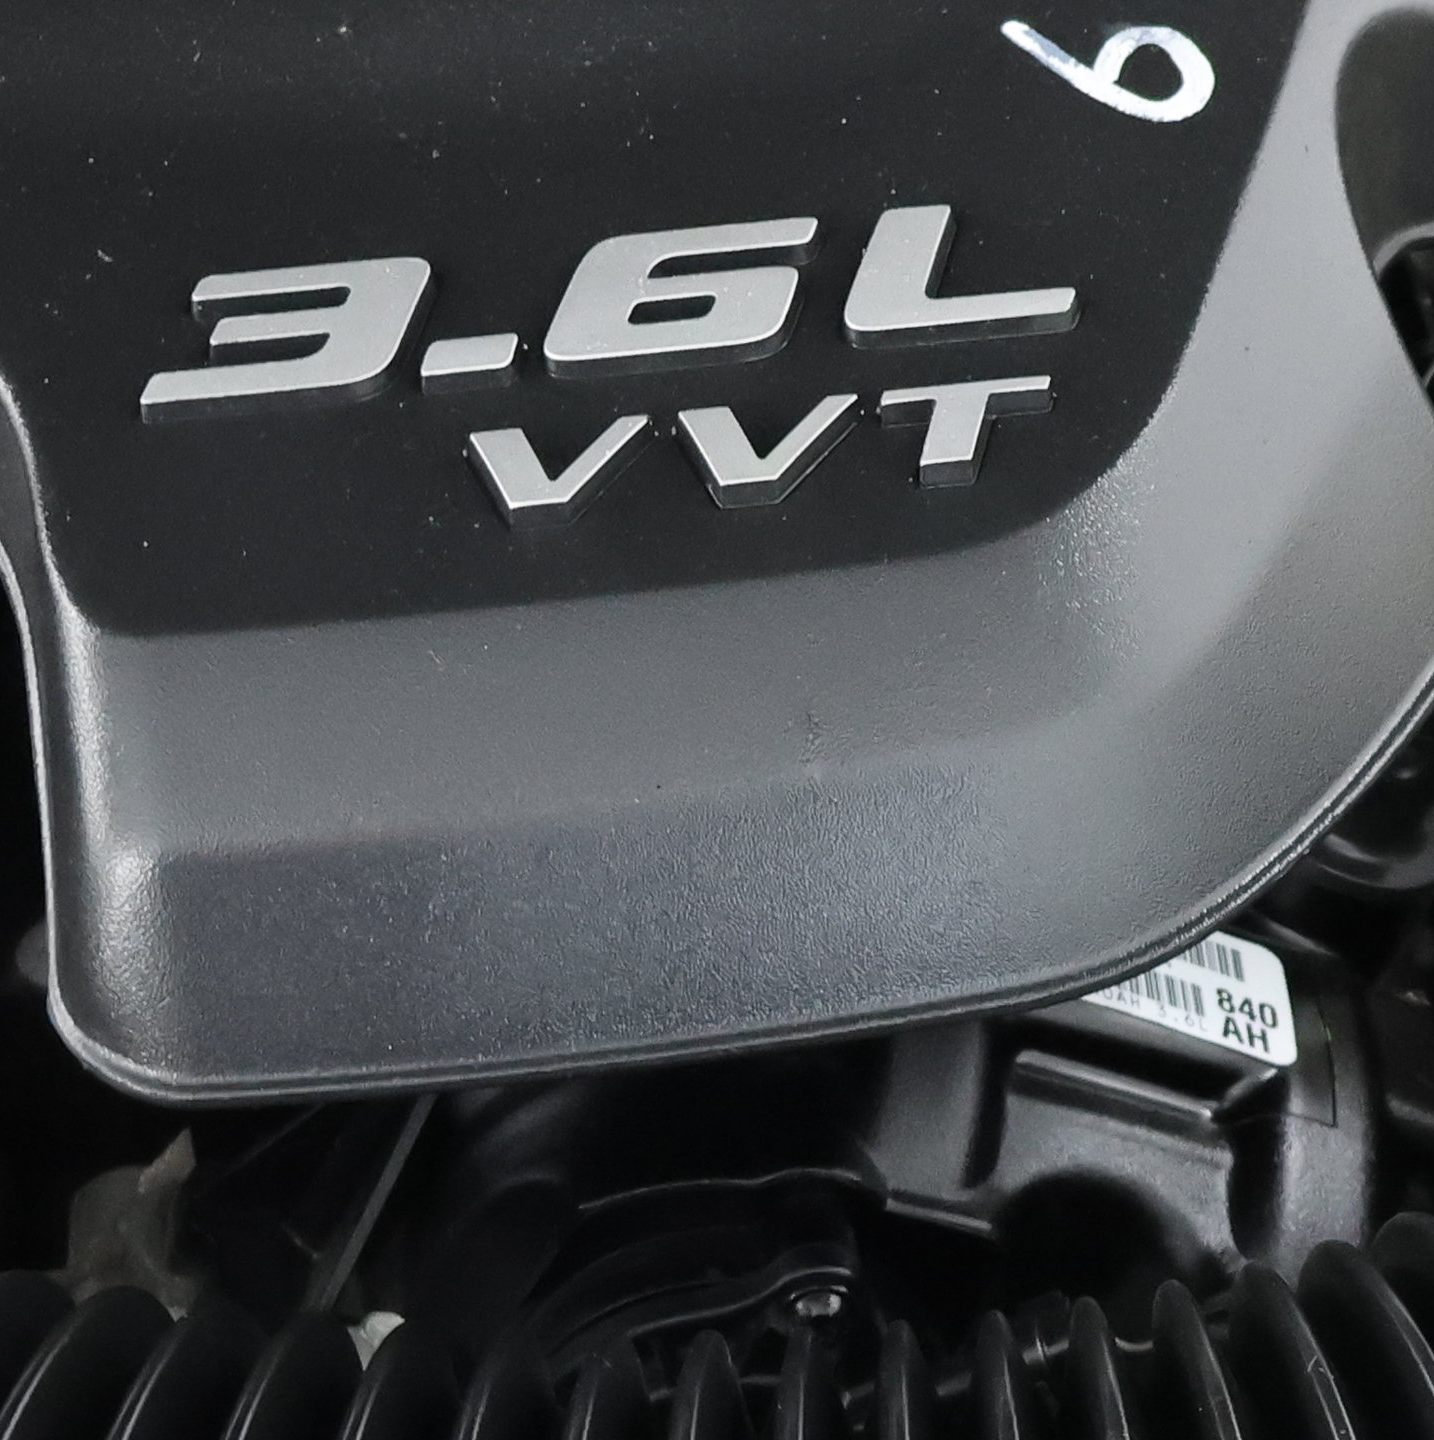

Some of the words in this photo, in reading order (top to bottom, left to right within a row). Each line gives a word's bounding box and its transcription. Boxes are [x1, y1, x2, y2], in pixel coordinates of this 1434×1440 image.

[1000, 19, 1215, 123] 6
[140, 204, 1080, 423] 3.6L
[467, 374, 1054, 525] VVT
[1216, 987, 1279, 1029] 840
[1222, 1017, 1271, 1054] AH
